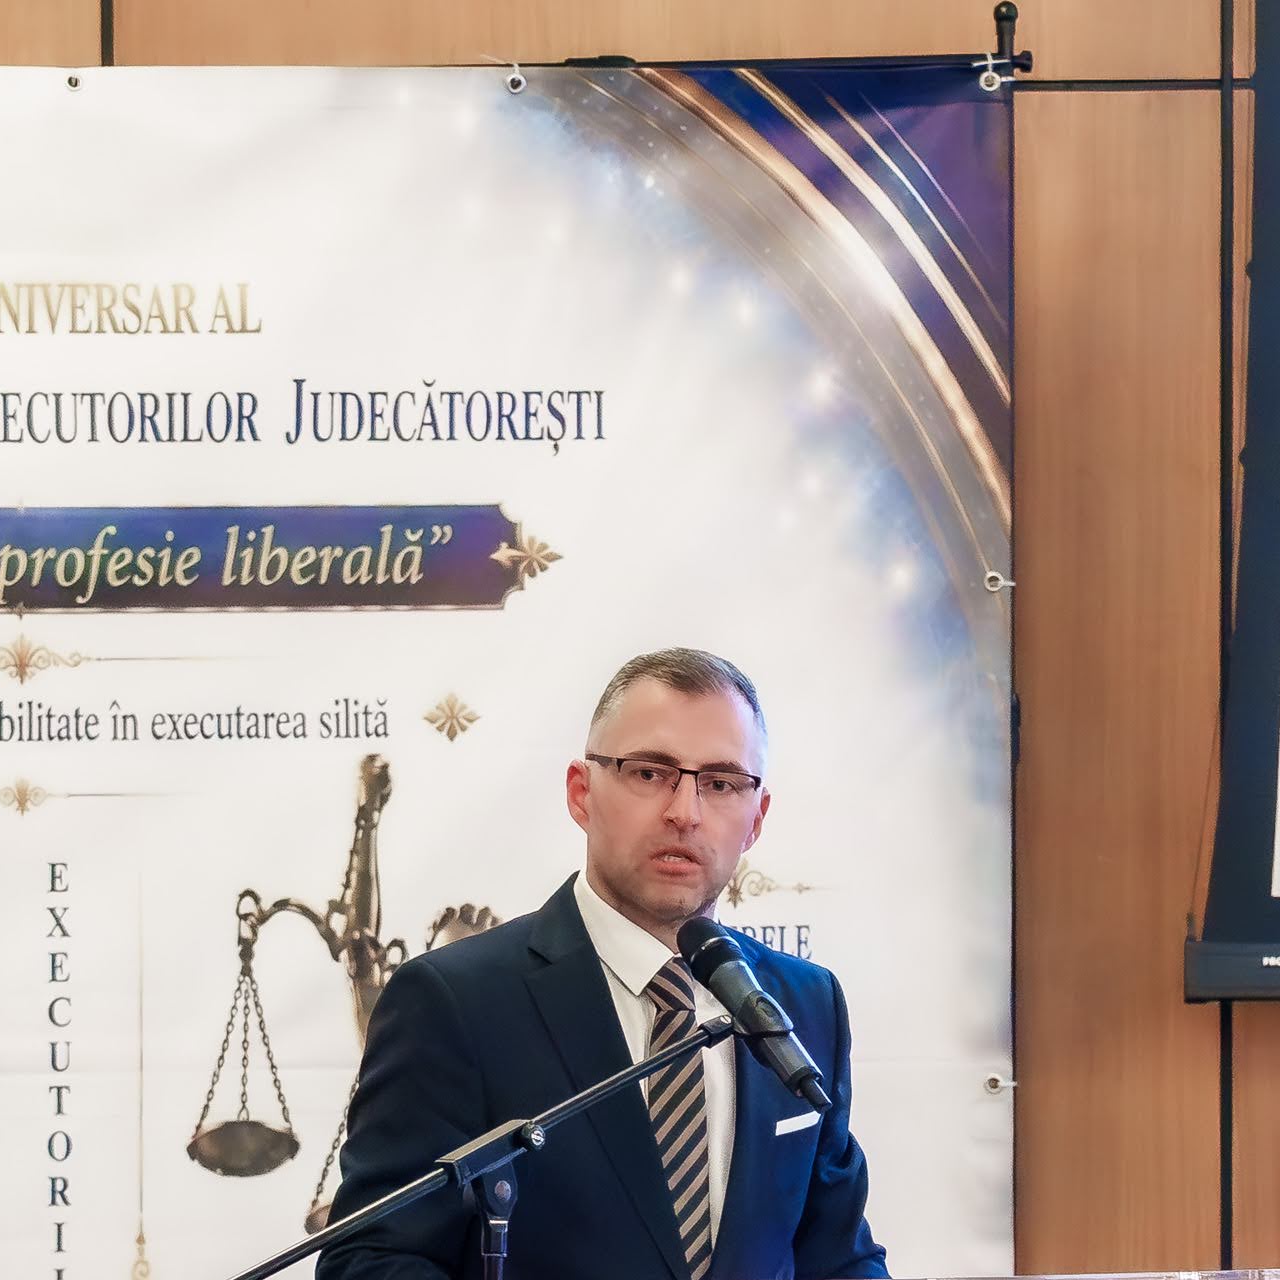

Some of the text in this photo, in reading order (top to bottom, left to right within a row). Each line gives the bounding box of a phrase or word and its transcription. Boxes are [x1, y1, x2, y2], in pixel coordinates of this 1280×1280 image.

[208, 281, 262, 335] AL
[285, 378, 606, 456] JUDECĂTOREȘTI
[110, 700, 139, 742] în
[150, 704, 308, 742] executarea
[319, 697, 390, 740] silită
